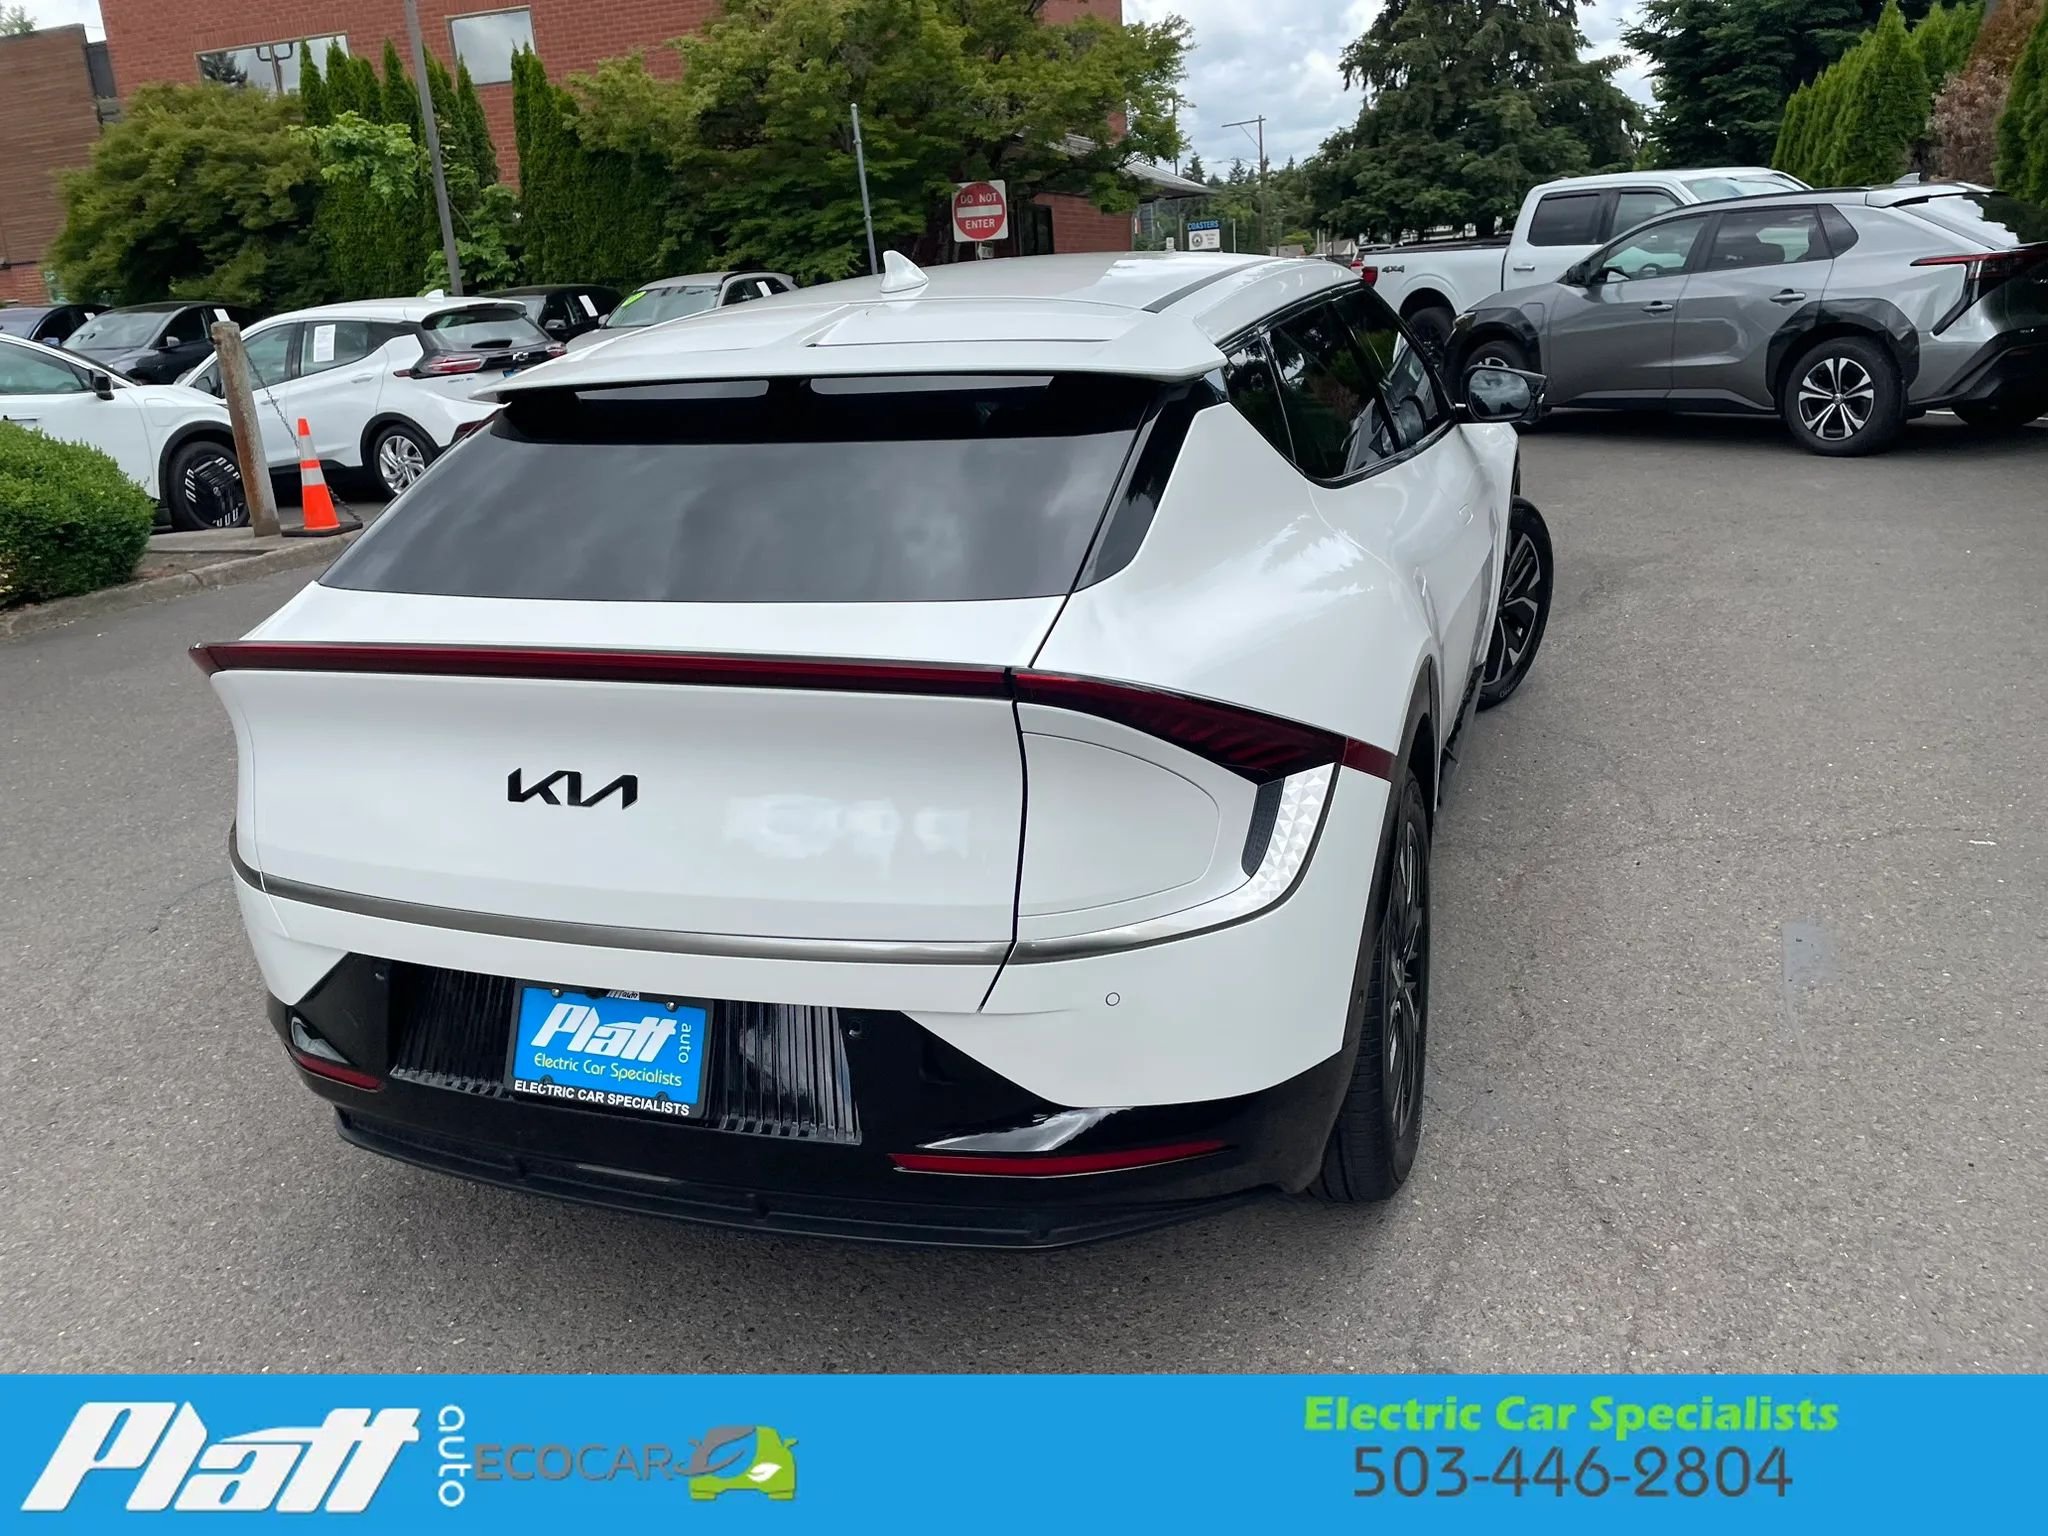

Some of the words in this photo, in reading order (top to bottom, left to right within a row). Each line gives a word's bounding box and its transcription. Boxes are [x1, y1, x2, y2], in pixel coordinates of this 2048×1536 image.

[960, 194, 974, 204] DO
[979, 192, 997, 203] NOT
[965, 219, 995, 230] ENTER
[1187, 220, 1219, 231] COASTERS
[507, 767, 638, 810] KIA
[530, 1003, 678, 1062] Platt
[678, 1022, 692, 1064] auto
[534, 1052, 579, 1072] Electric
[583, 1059, 606, 1076] Car
[610, 1062, 683, 1087] Specialists
[514, 1079, 575, 1098] ELECTRIC
[577, 1088, 605, 1104] CAR
[607, 1093, 690, 1117] SPECIALISTS
